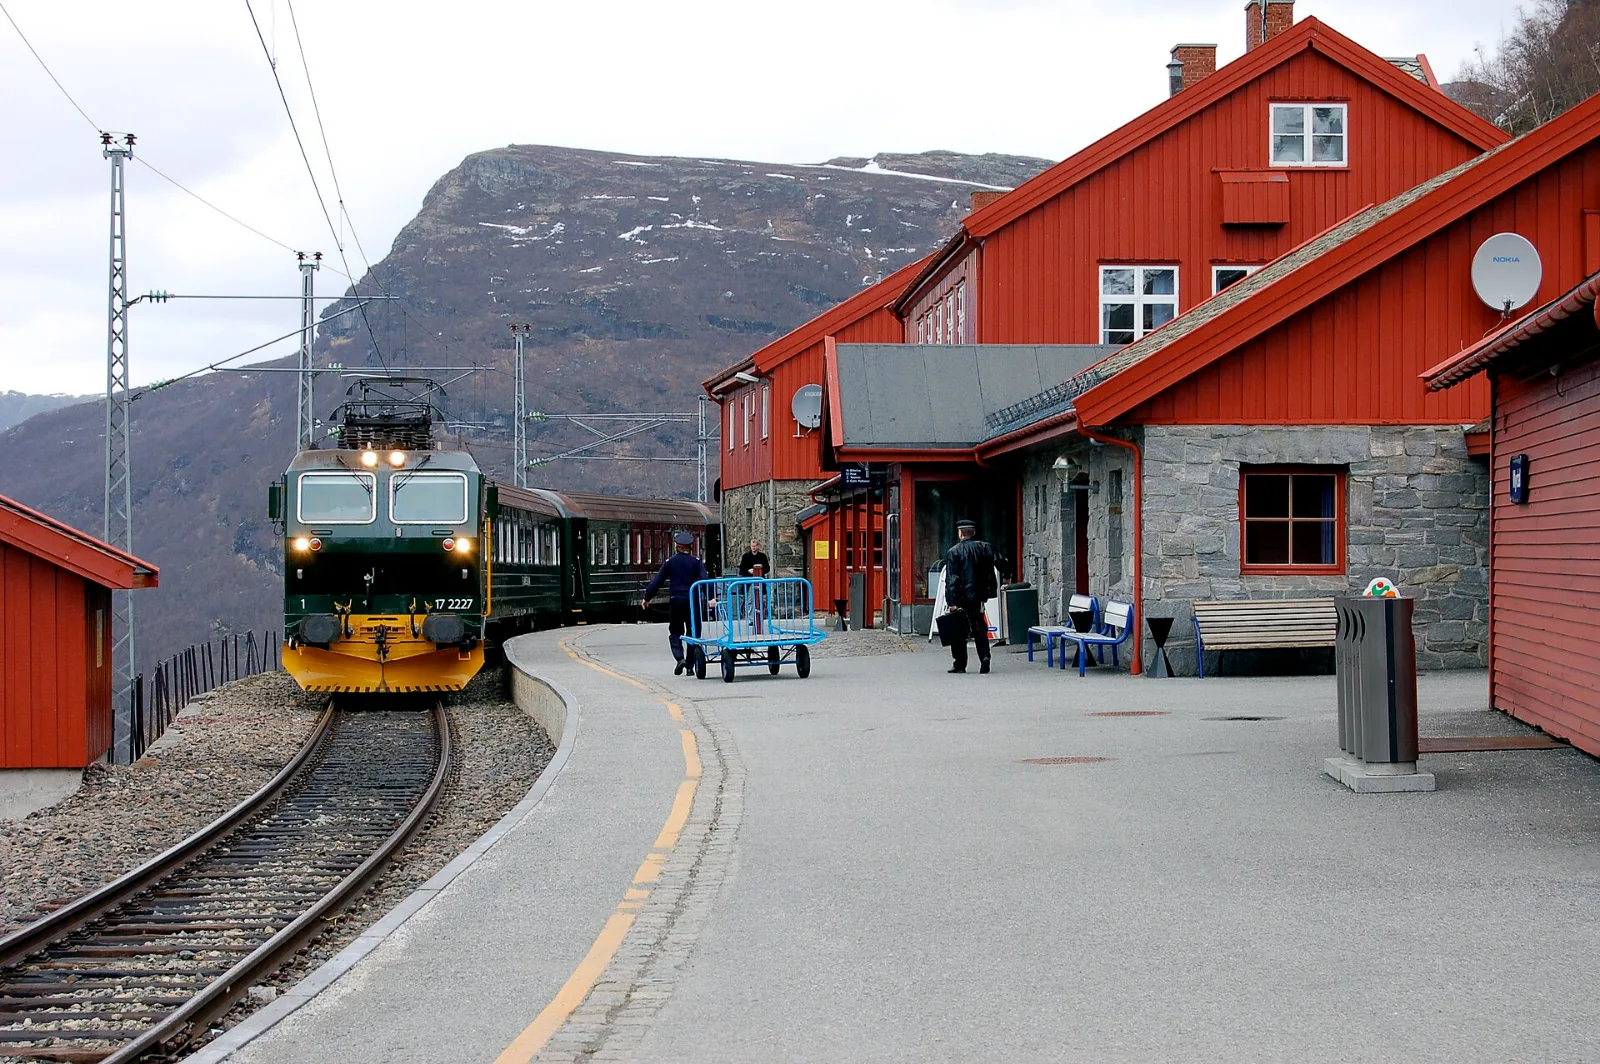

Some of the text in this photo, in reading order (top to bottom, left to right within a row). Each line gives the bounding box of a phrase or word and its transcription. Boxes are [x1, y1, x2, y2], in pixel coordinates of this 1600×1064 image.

[300, 598, 305, 610] 1
[435, 598, 474, 610] 17 2227
